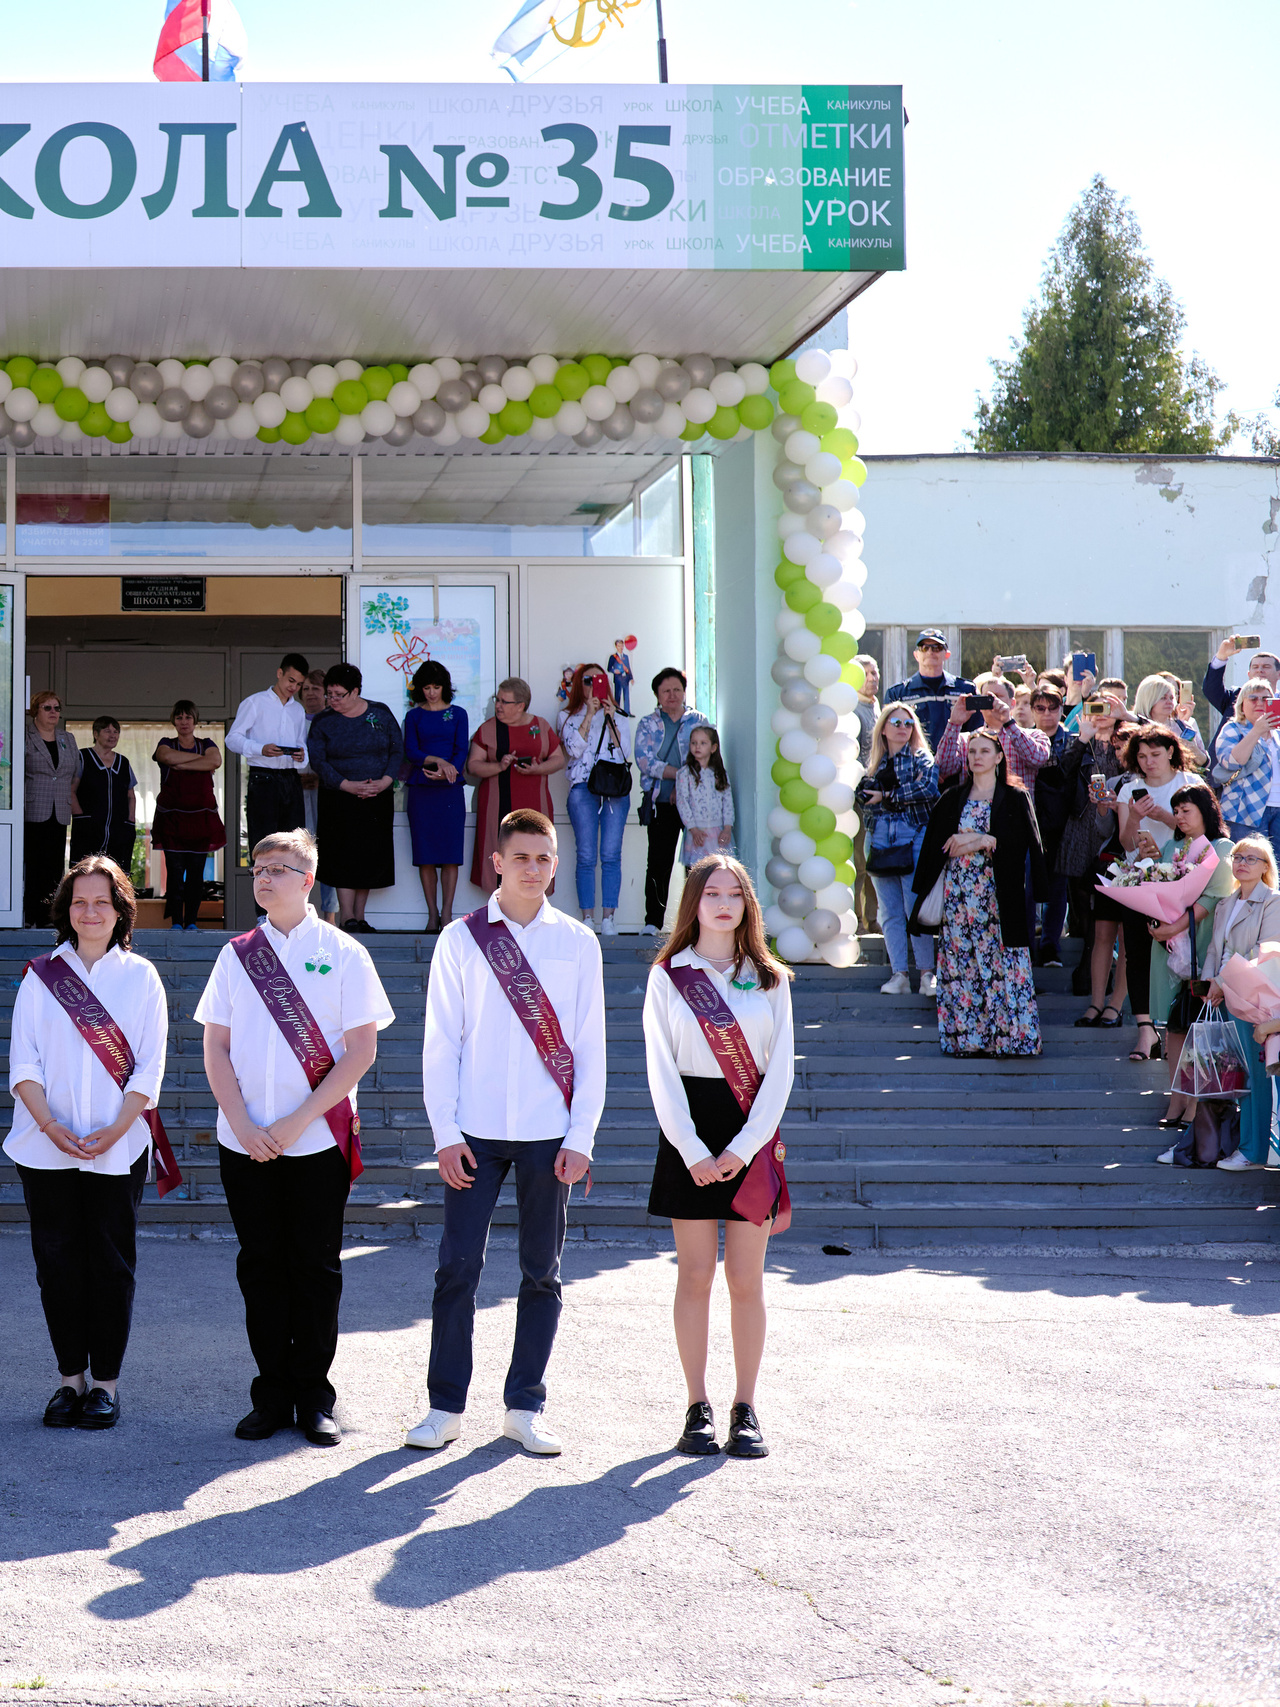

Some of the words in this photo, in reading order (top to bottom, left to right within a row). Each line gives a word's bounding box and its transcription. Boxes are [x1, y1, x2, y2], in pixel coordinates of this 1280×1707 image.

[428, 97, 500, 114] ШКОЛА
[508, 95, 603, 118] ДРУЗЬЯ
[623, 101, 653, 112] УРОК
[665, 99, 723, 112] ШКОЛА
[735, 96, 811, 115] УЧЕБА
[827, 100, 891, 110] КАНИКУЛЫ
[682, 134, 728, 145] ДРУЗЬЯ
[739, 123, 891, 149] ОТМЕТКИ
[539, 122, 675, 221] 35
[718, 167, 891, 187] ОБРАЗОВАНИЕ
[720, 205, 781, 220] ШКОЛА
[804, 199, 891, 226] УРОК
[428, 235, 501, 252] ШКОЛА
[508, 233, 604, 255] ДРУЗЬЯ
[624, 239, 654, 250] УРОК
[666, 237, 725, 250] ШКОЛА
[736, 234, 812, 253] УЧЕБА
[828, 237, 892, 248] КАНИКУЛЫ
[133, 597, 170, 605] ШКОЛА
[182, 597, 193, 605] 35
[268, 976, 319, 1056] Выпускник
[511, 972, 561, 1056] Выпускник
[709, 1012, 751, 1090] Выпускница
